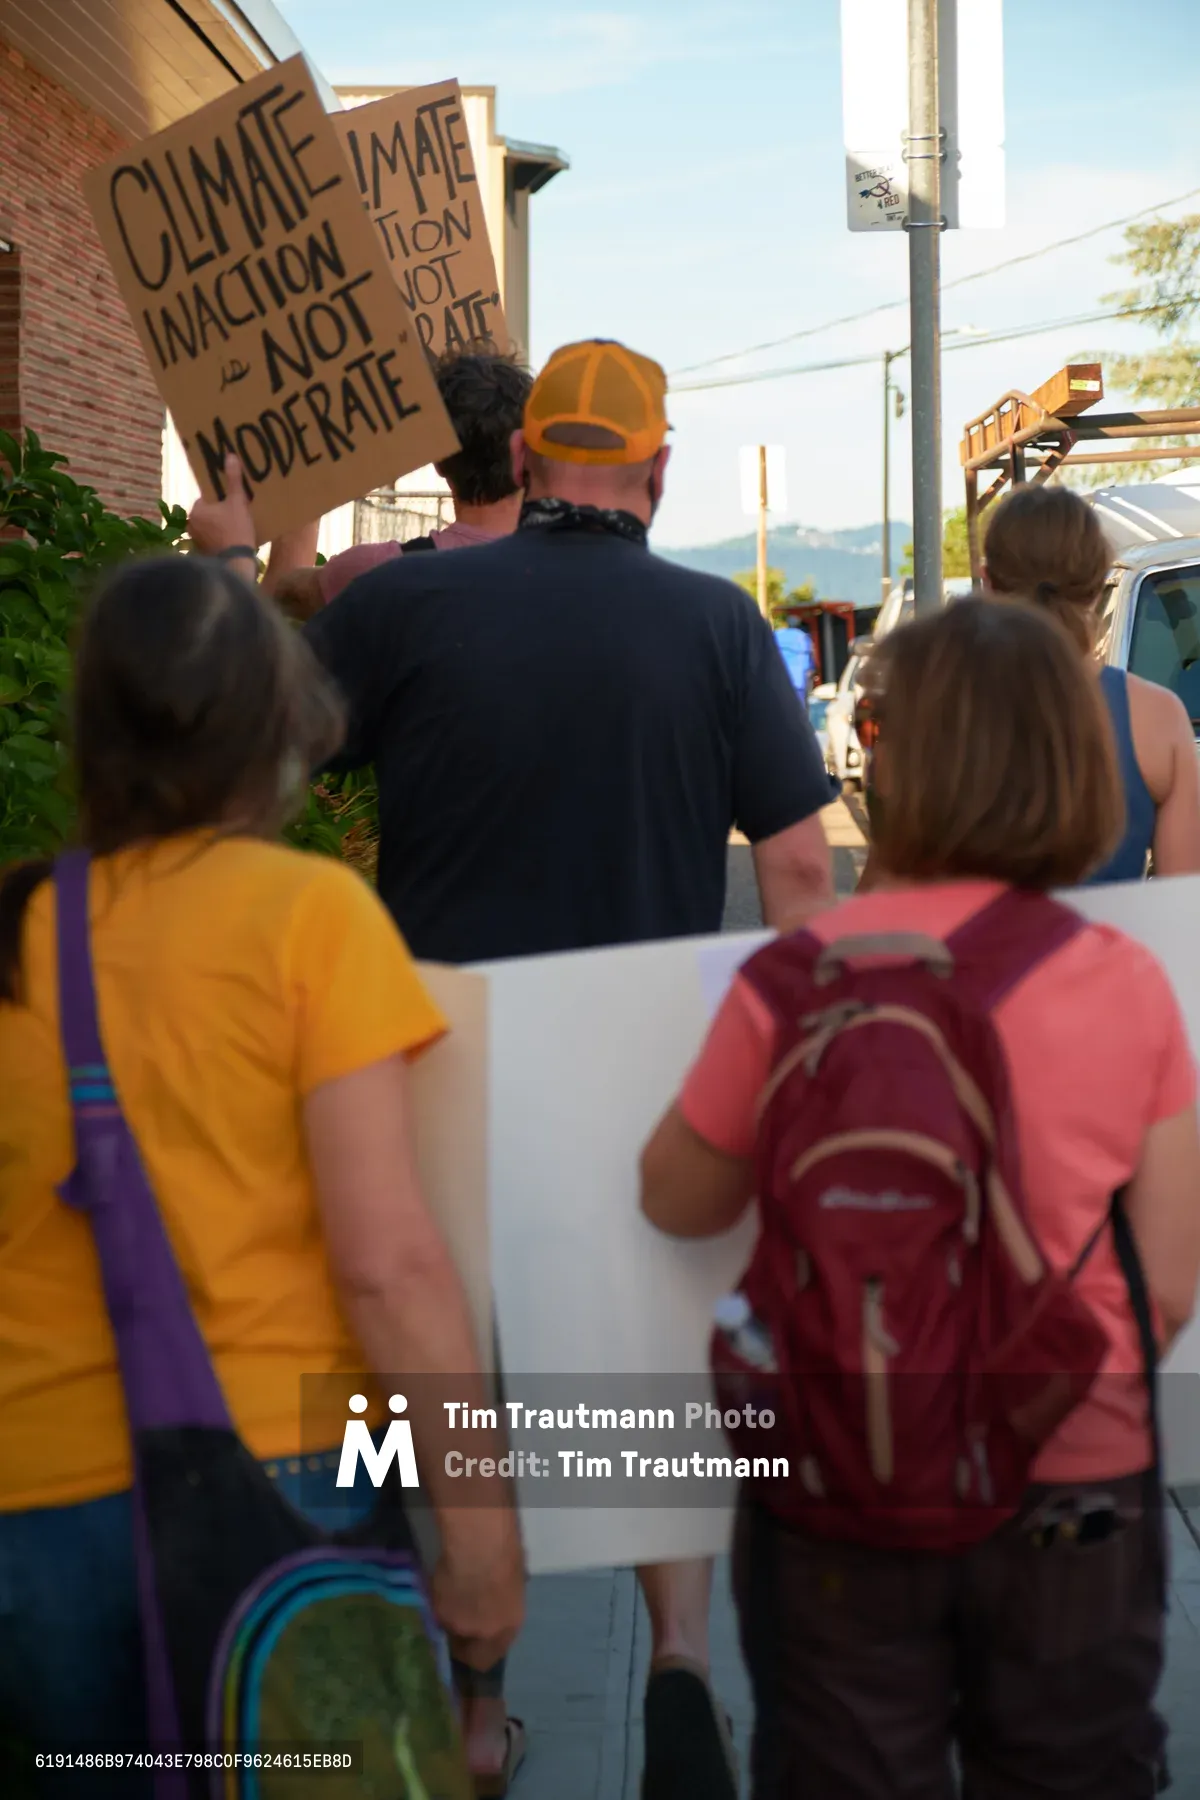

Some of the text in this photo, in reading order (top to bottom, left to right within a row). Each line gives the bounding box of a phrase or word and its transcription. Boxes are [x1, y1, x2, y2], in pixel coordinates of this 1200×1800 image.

[110, 84, 342, 291] CLIMATE
[346, 95, 476, 215] IMATE
[884, 194, 899, 208] RED
[375, 200, 471, 260] TION
[143, 220, 346, 371] INACTION
[261, 270, 373, 395] NOT
